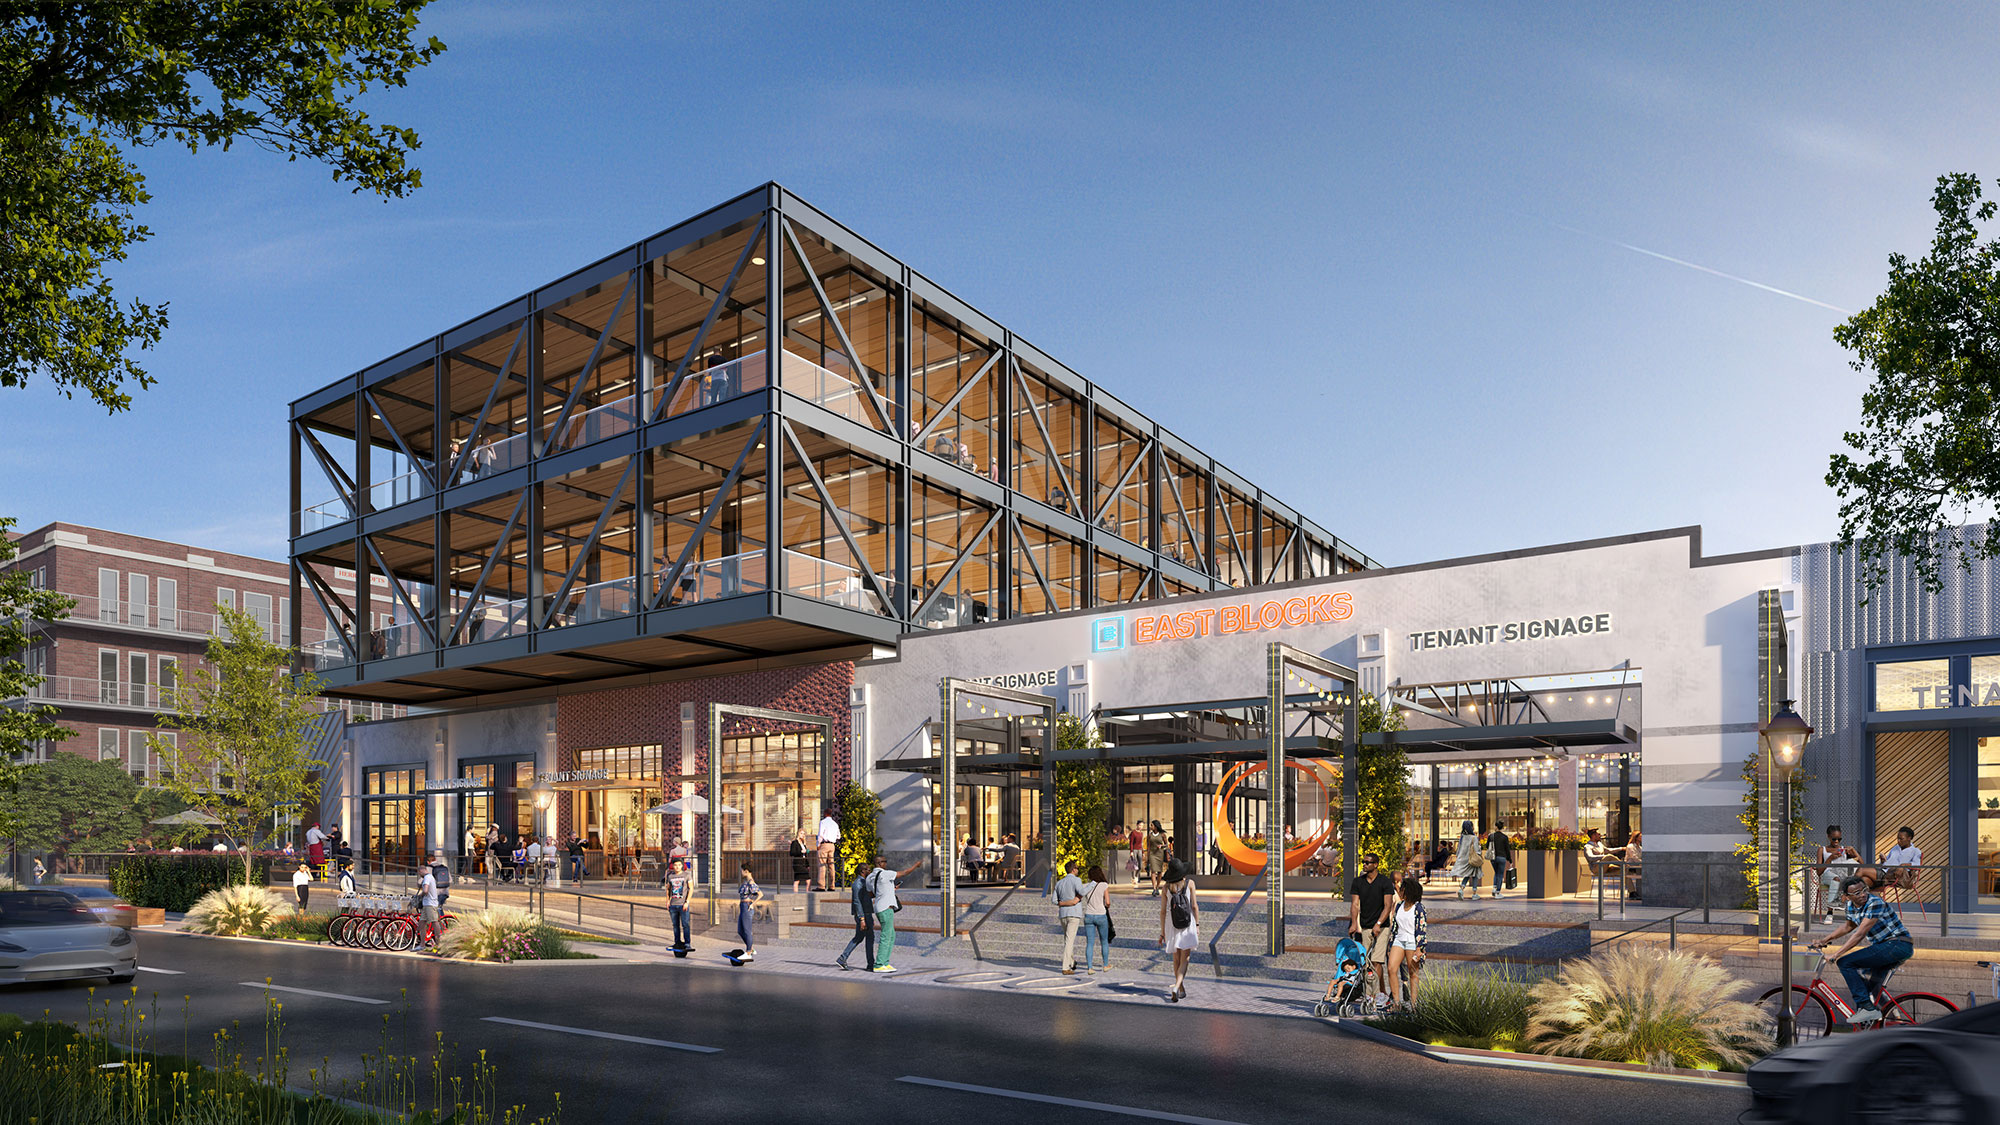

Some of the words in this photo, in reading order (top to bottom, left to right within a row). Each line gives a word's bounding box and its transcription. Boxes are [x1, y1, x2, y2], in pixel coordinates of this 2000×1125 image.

[1135, 609, 1216, 643] EAST
[1220, 592, 1354, 633] BLOCKS
[1409, 625, 1499, 650] TENANT
[1503, 613, 1610, 641] SIGNAGE
[994, 670, 1056, 688] SIGNAGE
[1911, 682, 2000, 709] TENA
[425, 778, 452, 790] TENANT
[452, 777, 484, 788] SIGNAGE
[571, 768, 609, 781] SIGNAGE
